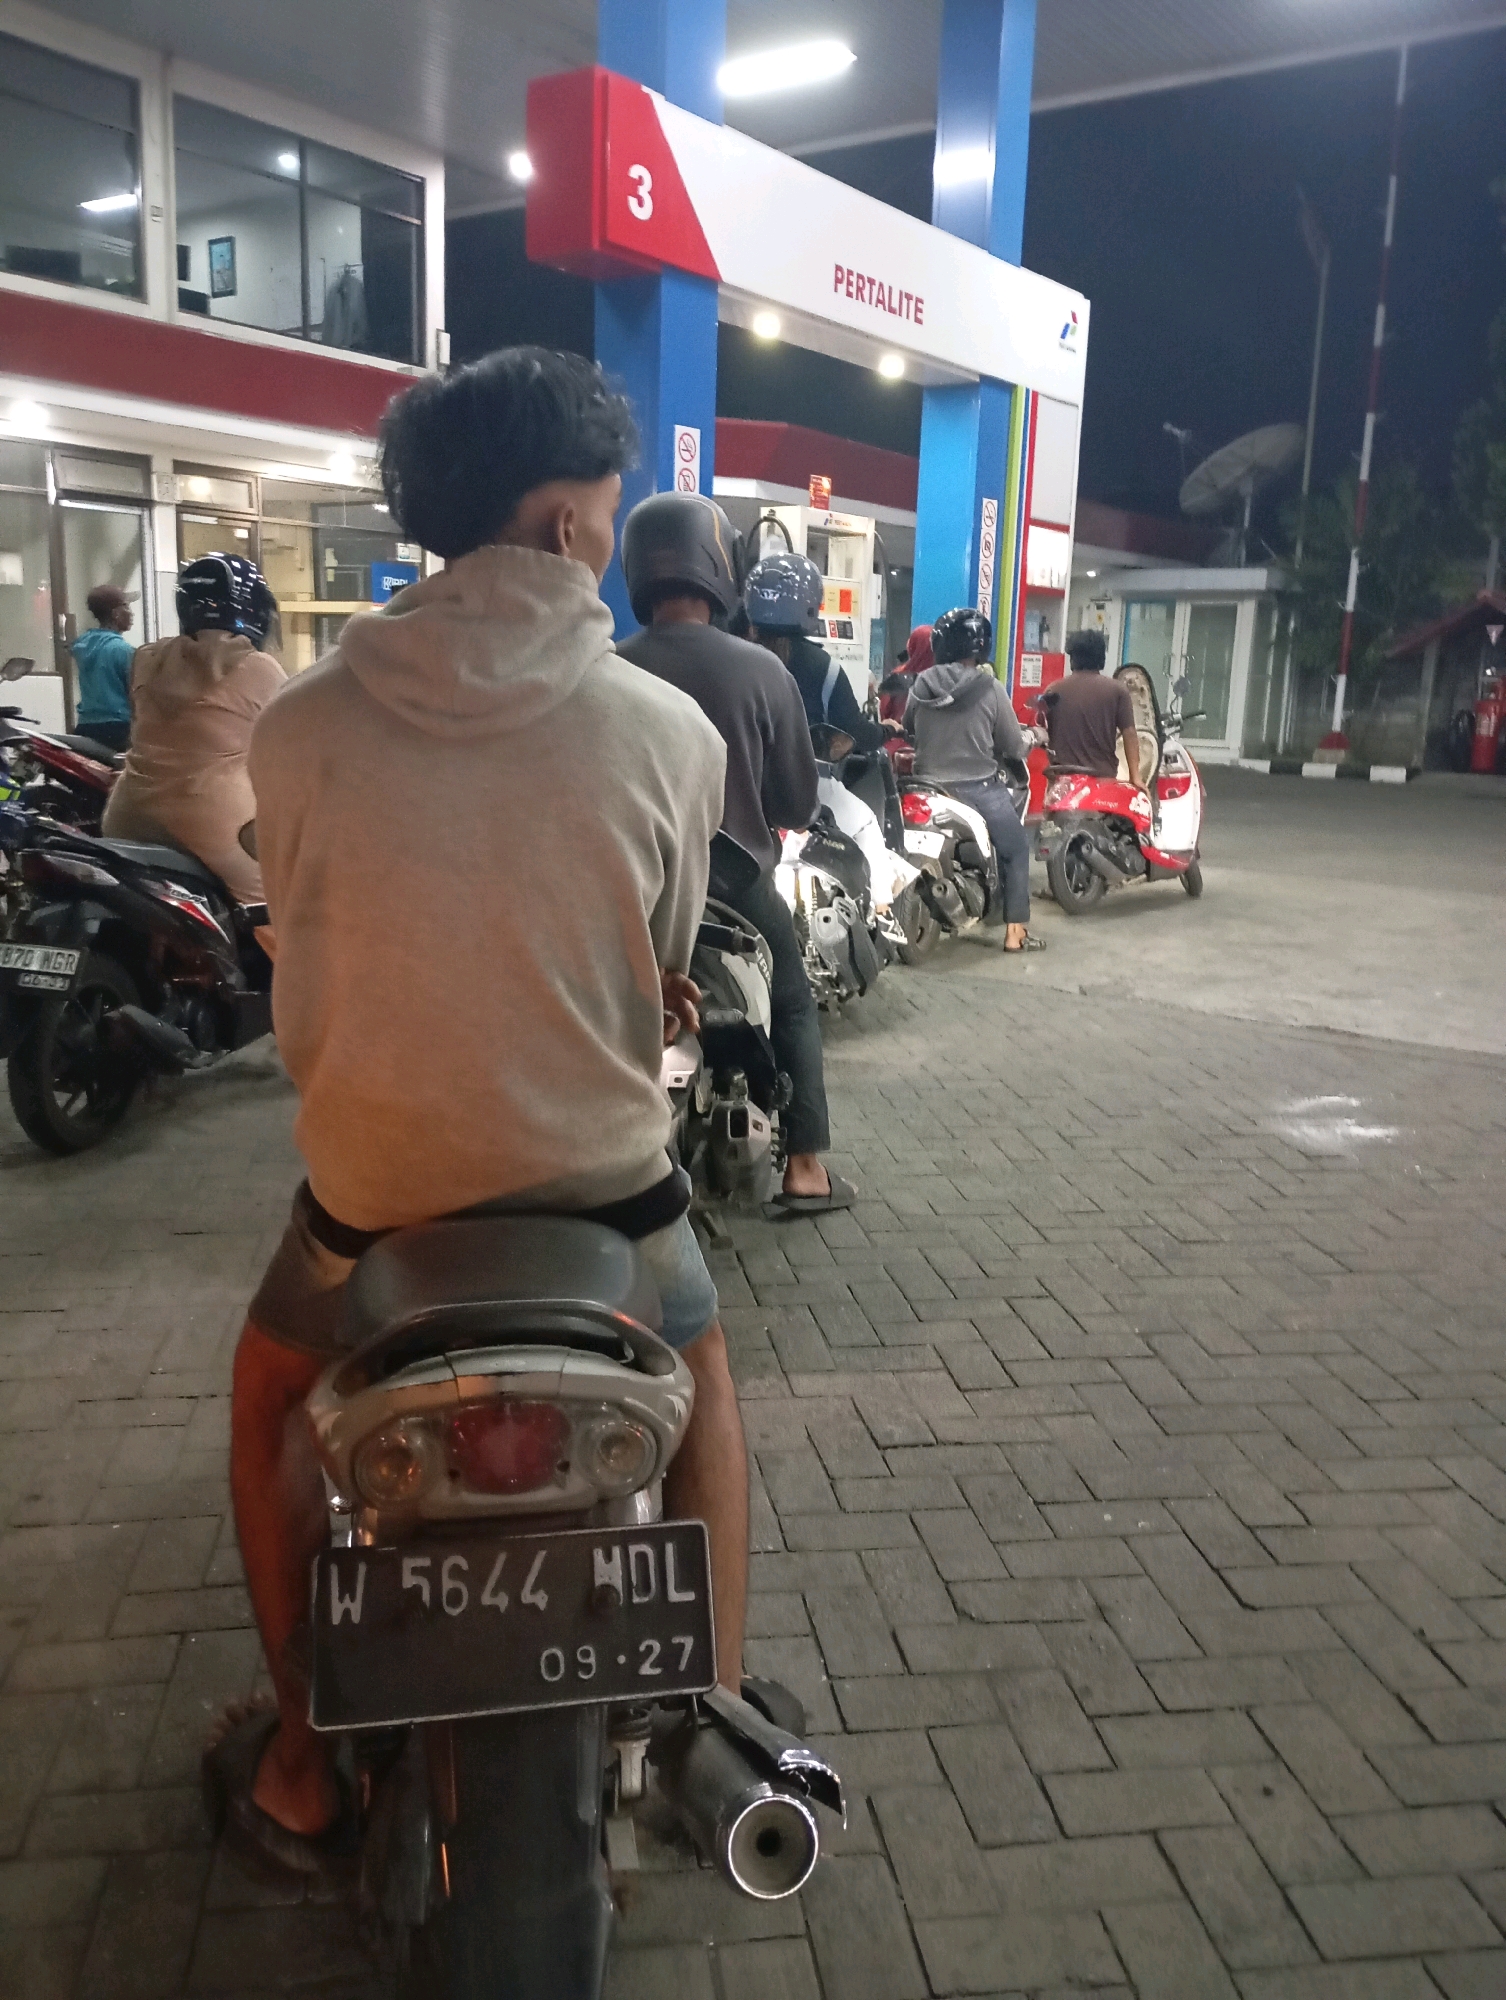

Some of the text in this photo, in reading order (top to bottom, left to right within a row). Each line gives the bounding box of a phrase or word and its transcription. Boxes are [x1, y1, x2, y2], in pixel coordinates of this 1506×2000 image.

[627, 163, 654, 221] 3
[834, 262, 925, 326] PERTALITE
[330, 1561, 367, 1625] W
[402, 1550, 549, 1616] 5644
